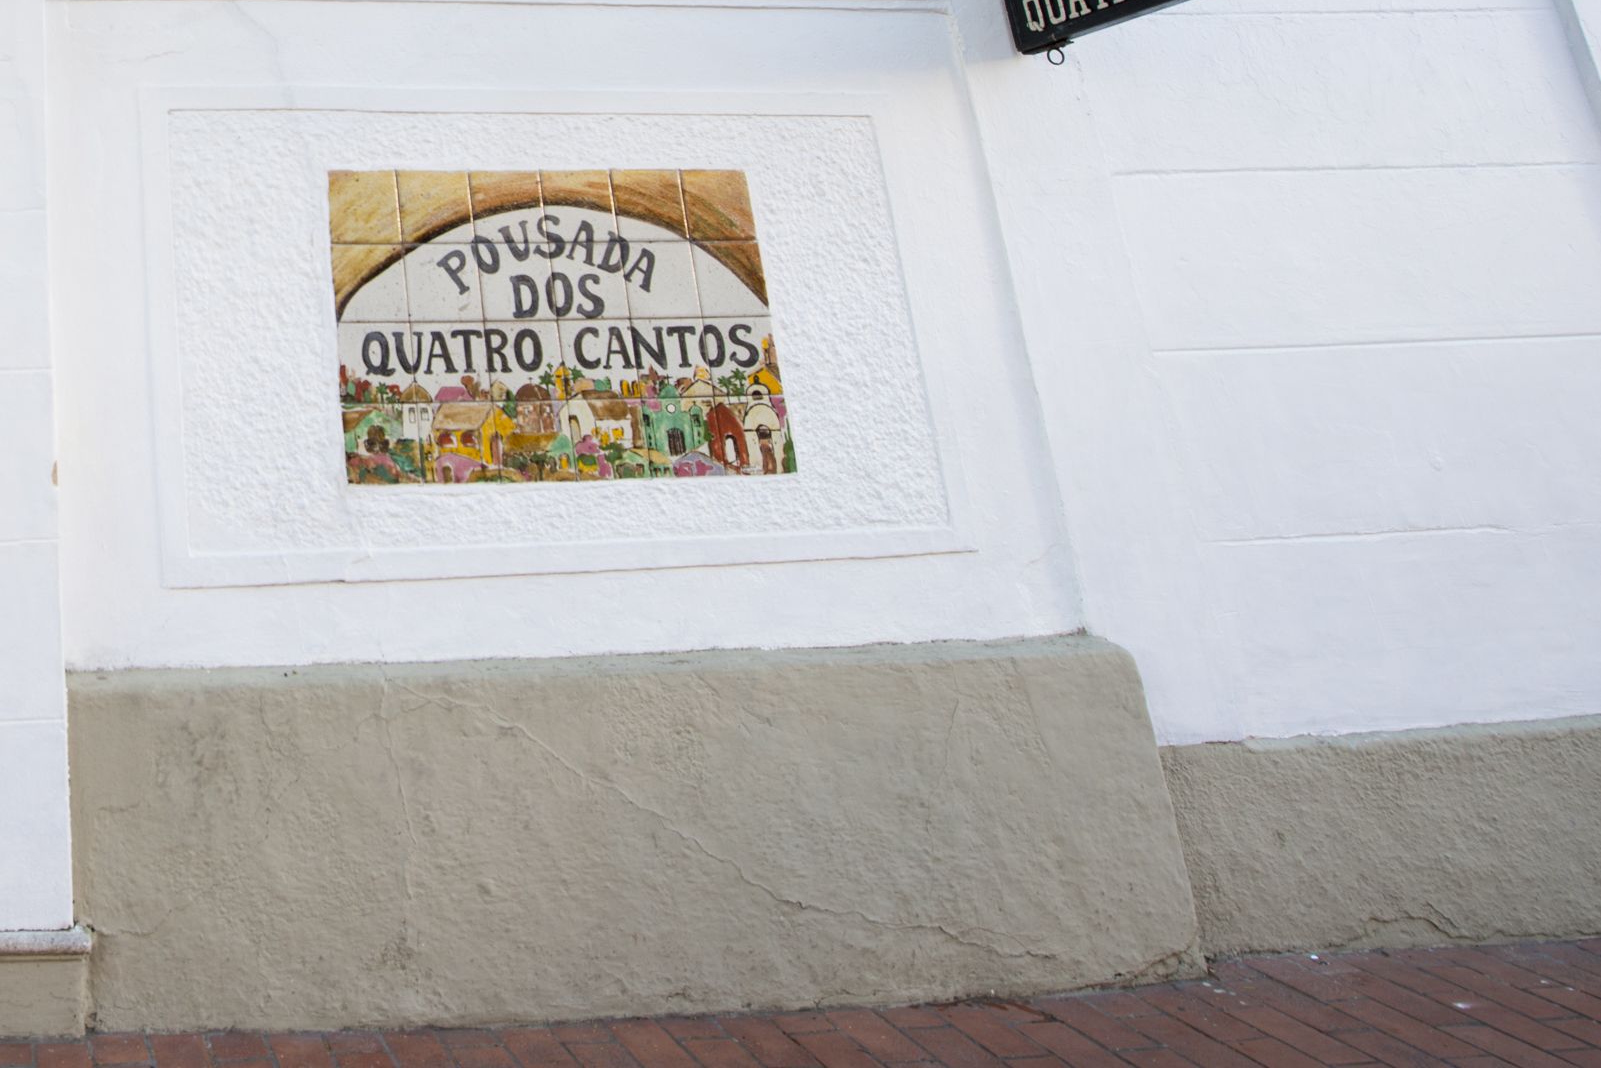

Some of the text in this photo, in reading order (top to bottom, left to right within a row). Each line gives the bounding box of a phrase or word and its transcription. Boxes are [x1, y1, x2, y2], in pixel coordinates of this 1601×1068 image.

[436, 214, 656, 296] POUSADA
[510, 272, 605, 319] DOS
[361, 324, 760, 376] QUATRO CANTOS
